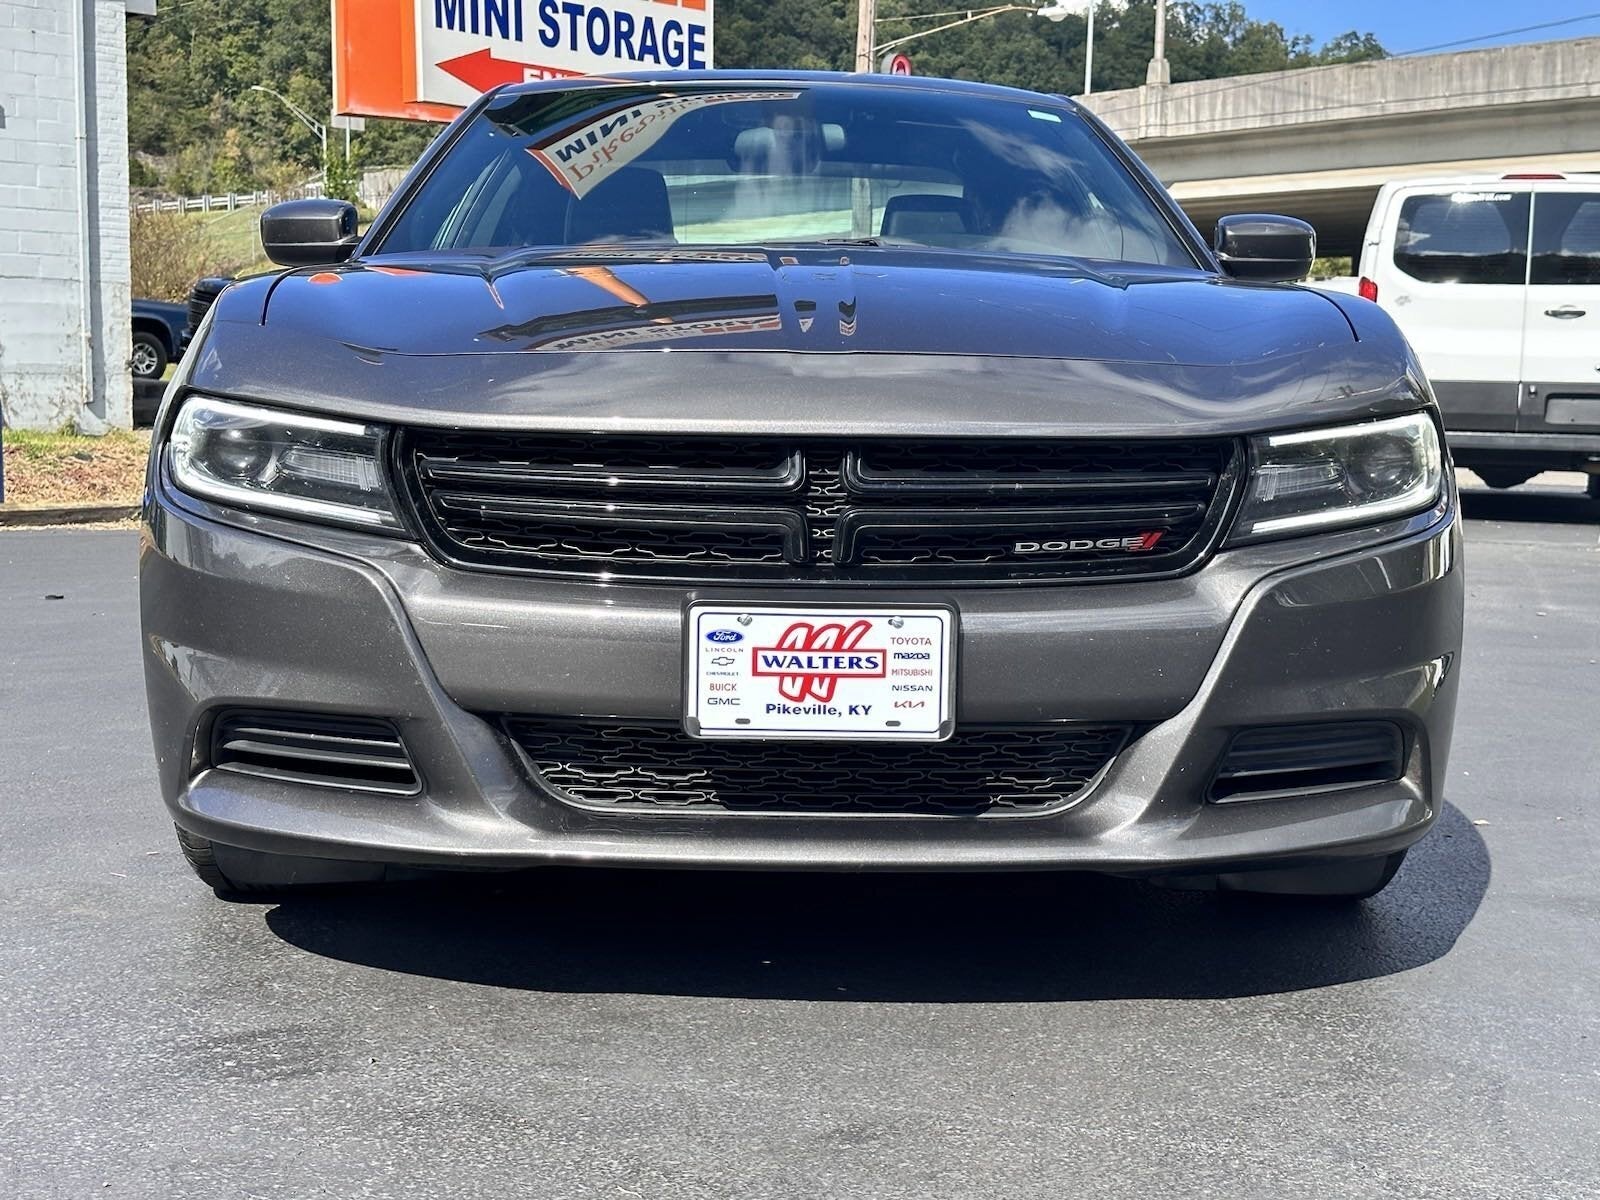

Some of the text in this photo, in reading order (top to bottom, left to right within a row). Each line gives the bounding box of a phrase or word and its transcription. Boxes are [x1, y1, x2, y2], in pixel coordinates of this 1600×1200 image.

[435, 0, 706, 69] MINI STORAGE
[1015, 537, 1144, 552] DODGE
[712, 630, 738, 641] Ford
[890, 637, 932, 645] TOYOTA
[761, 654, 880, 670] WALTERS
[891, 668, 933, 677] MITSUBISHI
[709, 683, 737, 692] BUICK
[707, 697, 741, 705] GMC
[765, 703, 872, 717] Pikeville, KY
